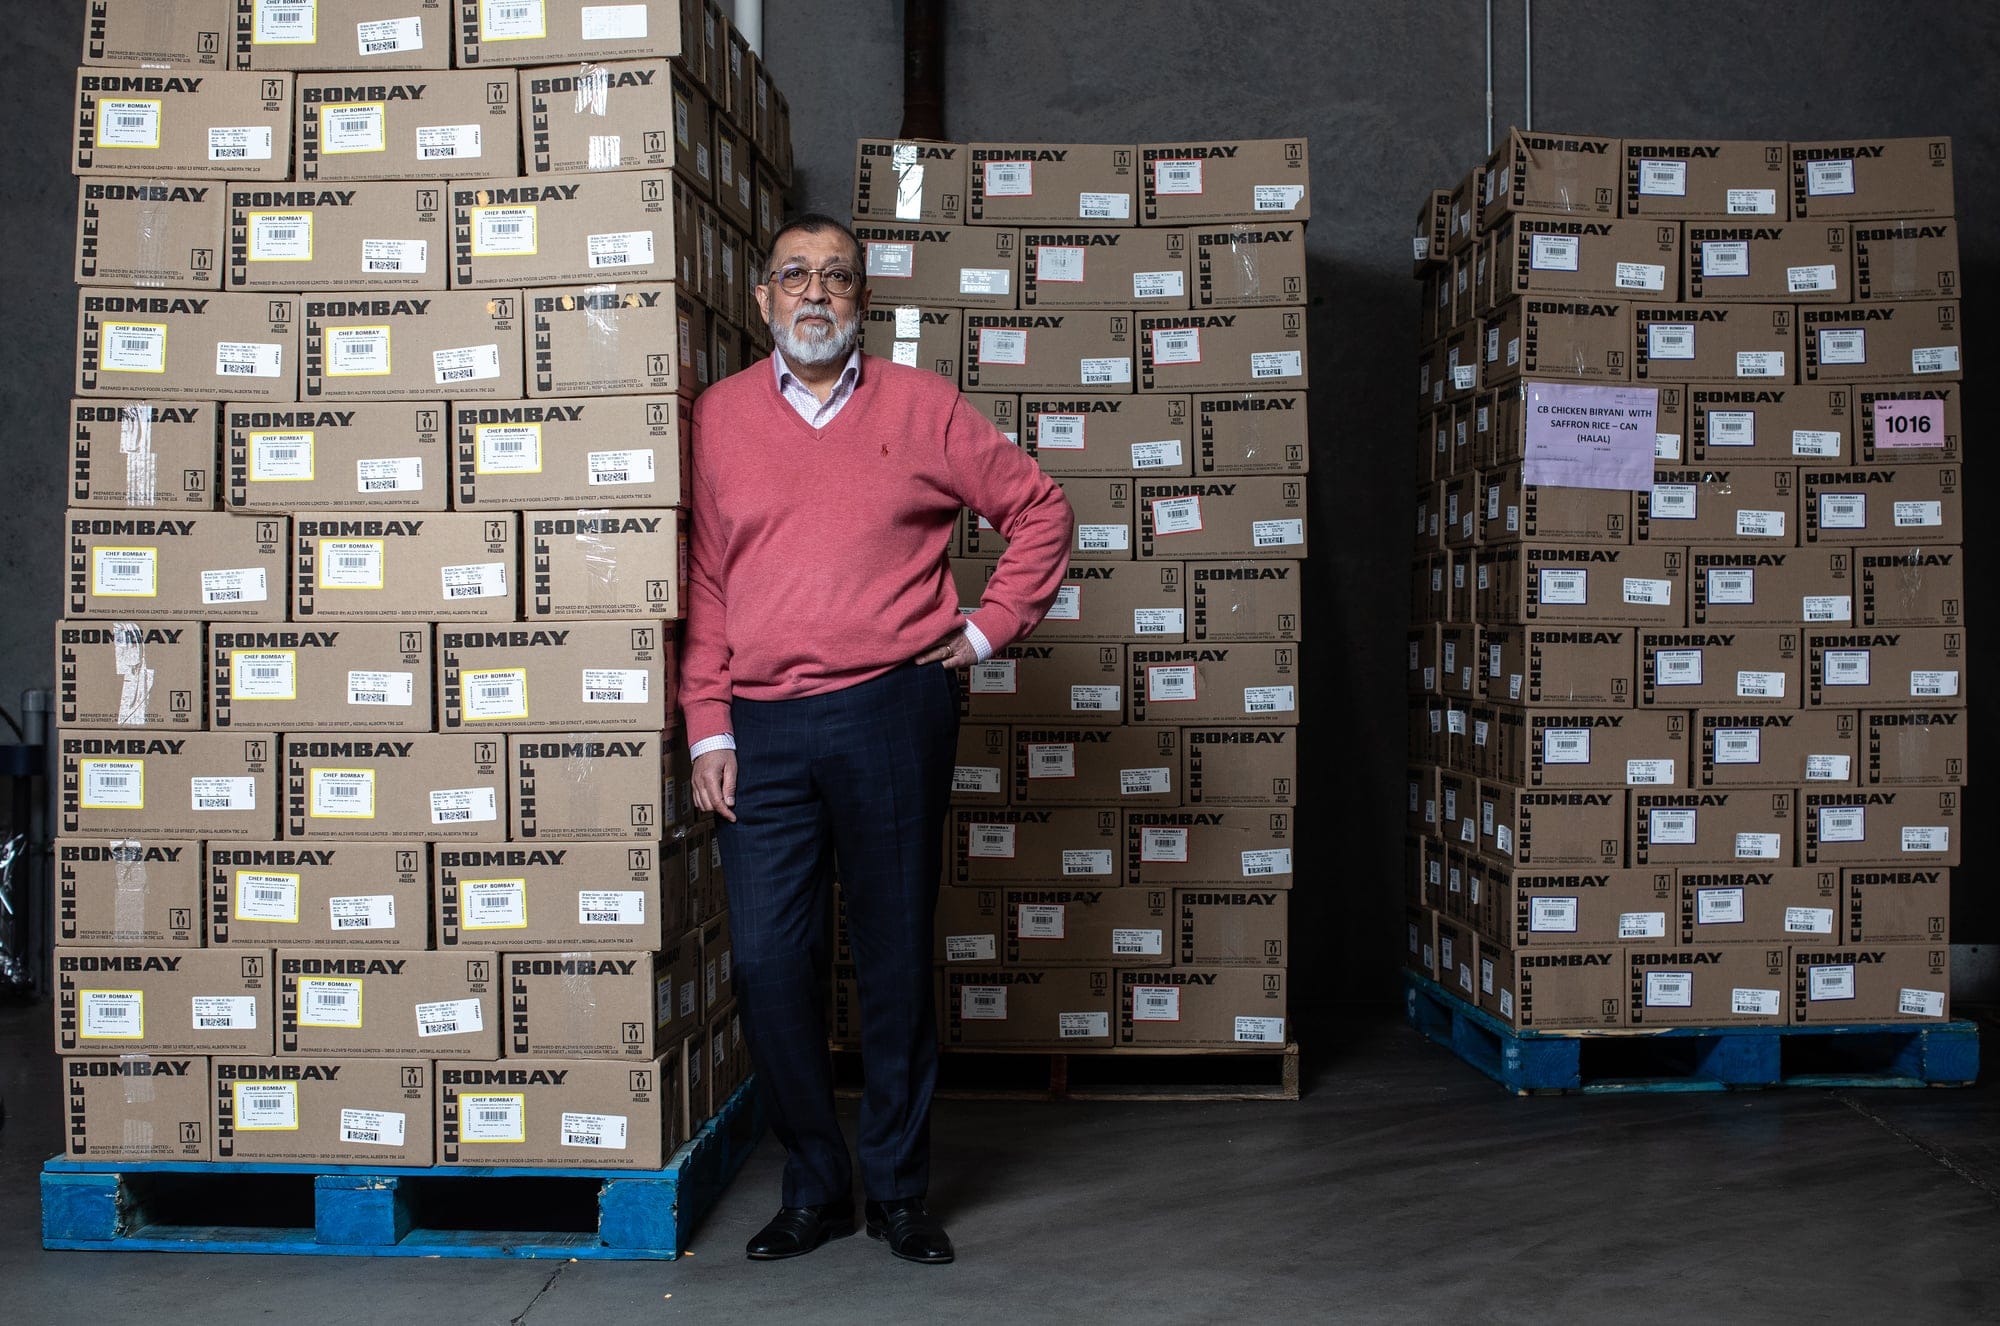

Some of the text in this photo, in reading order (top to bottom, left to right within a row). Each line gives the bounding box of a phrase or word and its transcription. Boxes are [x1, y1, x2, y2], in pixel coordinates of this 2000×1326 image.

[81, 76, 203, 92] BOMBAY
[304, 85, 426, 102] BOMBAY
[79, 92, 95, 168] CHEF
[532, 96, 550, 172] CHEF
[973, 149, 1068, 162] BOMBAY
[1144, 146, 1238, 160] BOMBAY
[1627, 146, 1720, 158] BOMBAY
[1792, 146, 1884, 159] BOMBAY
[86, 184, 209, 202] BOMBAY
[858, 157, 870, 214] CHEF
[232, 191, 356, 206] BOMBAY
[856, 229, 951, 242] BOMBAY
[1519, 221, 1613, 235] BOMBAY
[1691, 228, 1783, 240] BOMBAY
[1856, 226, 1947, 240] BOMBAY
[455, 208, 472, 284] CHEF
[1026, 233, 1120, 246] BOMBAY
[1198, 231, 1294, 246] BOMBAY
[232, 209, 246, 285] CHEF
[1199, 248, 1212, 304] CHEF
[1858, 243, 1869, 298] CHEF
[84, 297, 209, 314] BOMBAY
[306, 300, 431, 317] BOMBAY
[1527, 302, 1619, 316] BOMBAY
[969, 315, 1065, 329] BOMBAY
[1142, 315, 1237, 329] BOMBAY
[1637, 309, 1729, 321] BOMBAY
[1804, 308, 1895, 322] BOMBAY
[306, 320, 321, 396] CHEF
[1807, 323, 1819, 380] CHEF
[1693, 391, 1785, 403] BOMBAY
[1201, 398, 1296, 412] BOMBAY
[1537, 405, 1652, 418] CB CHICKEN BIRYANI WITH
[232, 411, 355, 428] BOMBAY
[459, 406, 585, 424] BOMBAY
[1551, 420, 1589, 429] SAFFRON
[1592, 421, 1610, 430] RICE
[1620, 422, 1638, 431] CAN
[1884, 416, 1931, 433] 1016
[1202, 415, 1214, 471] CHEF
[1577, 434, 1611, 444] (HALAL)
[75, 423, 90, 499] CHEF
[231, 429, 246, 506] CHEF
[1805, 471, 1895, 484] BOMBAY
[1141, 484, 1236, 496] BOMBAY
[72, 520, 196, 536] BOMBAY
[299, 521, 424, 536] BOMBAY
[535, 518, 662, 535] BOMBAY
[1528, 550, 1620, 561] BOMBAY
[1695, 555, 1787, 566] BOMBAY
[1863, 554, 1953, 567] BOMBAY
[71, 536, 86, 613] CHEF
[535, 537, 550, 614] CHEF
[1195, 568, 1290, 581] BOMBAY
[1195, 583, 1206, 640] CHEF
[215, 632, 339, 648] BOMBAY
[444, 631, 570, 648] BOMBAY
[1530, 632, 1623, 644] BOMBAY
[1643, 635, 1735, 646] BOMBAY
[1810, 635, 1900, 646] BOMBAY
[1133, 650, 1229, 662] BOMBAY
[62, 646, 77, 721] CHEF
[1810, 649, 1821, 705] CHEF
[444, 650, 460, 727] CHEF
[1531, 715, 1623, 728] BOMBAY
[1703, 715, 1794, 727] BOMBAY
[1869, 713, 1957, 726] BOMBAY
[1016, 731, 1112, 742] BOMBAY
[1190, 732, 1285, 744] BOMBAY
[64, 740, 185, 755] BOMBAY
[289, 742, 414, 757] BOMBAY
[520, 742, 646, 758] BOMBAY
[1190, 745, 1202, 802] CHEF
[289, 759, 305, 835] CHEF
[520, 760, 536, 837] CHEF
[1521, 794, 1613, 805] BOMBAY
[1637, 795, 1729, 806] BOMBAY
[1807, 793, 1896, 805] BOMBAY
[957, 811, 1052, 824] BOMBAY
[1129, 814, 1224, 825] BOMBAY
[1519, 807, 1531, 863] CHEF
[213, 850, 335, 865] BOMBAY
[441, 850, 566, 866] BOMBAY
[1518, 876, 1610, 887] BOMBAY
[1682, 874, 1773, 885] BOMBAY
[1851, 873, 1940, 884] BOMBAY
[213, 867, 229, 943] CHEF
[1008, 891, 1102, 904] BOMBAY
[1182, 893, 1277, 905] BOMBAY
[1182, 907, 1194, 963] CHEF
[60, 957, 182, 972] BOMBAY
[1521, 954, 1613, 966] BOMBAY
[1631, 952, 1723, 964] BOMBAY
[1796, 952, 1885, 964] BOMBAY
[282, 959, 406, 975] BOMBAY
[512, 960, 637, 975] BOMBAY
[950, 972, 1044, 984] BOMBAY
[1123, 972, 1217, 984] BOMBAY
[1521, 968, 1532, 1025] CHEF
[61, 973, 76, 1049] CHEF
[283, 975, 298, 1052] CHEF
[70, 1061, 191, 1077] BOMBAY
[218, 1065, 341, 1080] BOMBAY
[442, 1070, 568, 1085] BOMBAY
[70, 1078, 86, 1154] CHEF
[443, 1086, 458, 1162] CHEF
